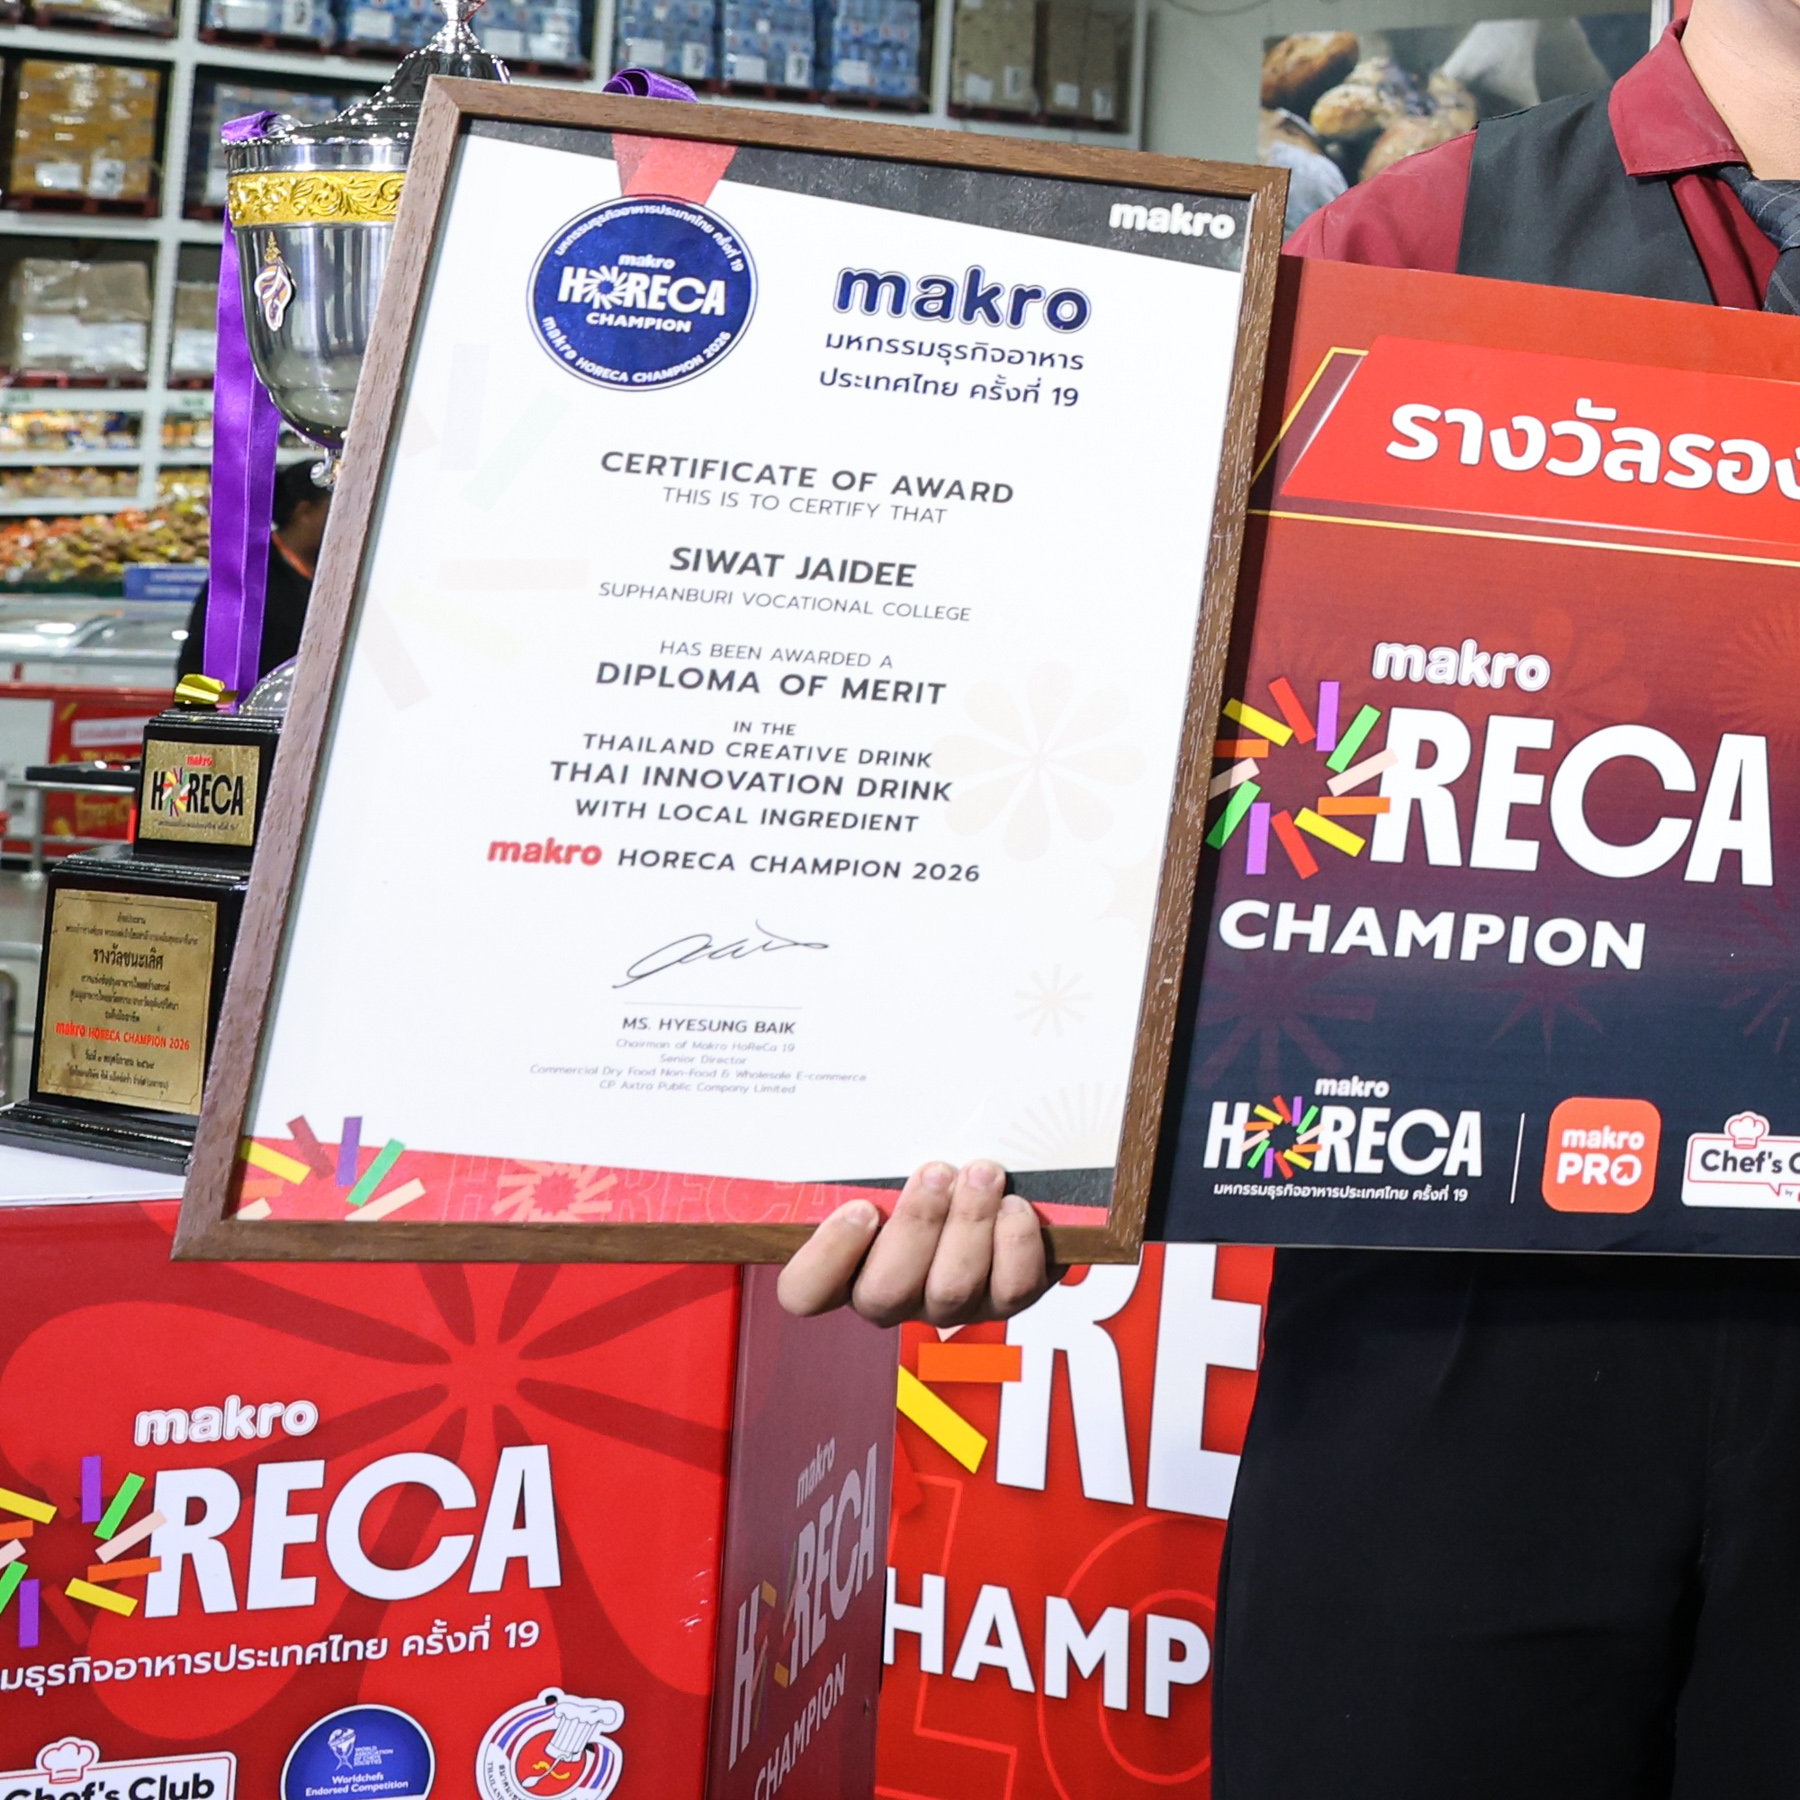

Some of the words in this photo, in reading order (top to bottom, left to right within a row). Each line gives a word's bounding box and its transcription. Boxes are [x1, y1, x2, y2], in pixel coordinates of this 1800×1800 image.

[1109, 201, 1236, 240] makro
[618, 254, 676, 270] makro
[558, 265, 726, 316] HORECA
[833, 265, 1092, 334] makro
[586, 312, 692, 333] CHAMPION
[542, 316, 577, 360] makro
[575, 358, 629, 382] HORECA
[632, 355, 704, 383] CHAMPION
[703, 331, 731, 359] 2026
[824, 333, 1085, 370] มหกรรมธุรกิจอาหาร
[819, 368, 959, 397] ประเทศไทย
[970, 374, 1040, 405] ครั้งที่
[1052, 386, 1079, 407] 19
[601, 451, 817, 488] CERTIFICATE
[831, 470, 877, 492] OF
[890, 475, 1014, 503] AWARD
[663, 486, 710, 506] THIS
[721, 491, 739, 508] IS
[750, 493, 780, 510] TO
[789, 497, 880, 518] CERTIFY
[890, 505, 947, 524] THAT
[670, 547, 785, 578] SIWAT
[795, 556, 917, 588] JAIDEE
[598, 581, 734, 605] SUPHANBURI
[742, 591, 874, 615] VOCATIONAL
[882, 602, 971, 621] COLLEGE
[659, 640, 702, 657] HAS
[710, 643, 762, 660] BEEN
[770, 648, 871, 667] AWARDED
[879, 655, 893, 668] A
[1372, 638, 1552, 692] makro
[596, 662, 760, 693] DIPLOMA
[779, 673, 827, 697] OF
[841, 677, 947, 705] MERIT
[733, 720, 752, 733] IN
[761, 722, 797, 736] THE
[583, 733, 715, 758] THAILAND
[725, 742, 847, 763] CREATIVE
[858, 749, 932, 769] DRINK
[151, 767, 243, 817] HORECA
[550, 761, 629, 785] THAI
[643, 766, 844, 796] INNOVATION
[856, 778, 952, 801] DRINK
[1208, 677, 1773, 887] ORECA
[575, 798, 646, 819] WITH
[658, 803, 749, 825] LOCAL
[760, 808, 919, 832] INGREDIENT
[487, 837, 602, 866] makro
[617, 848, 735, 871] HORECA
[750, 855, 901, 880] CHAMPION
[911, 862, 981, 882] 2026
[1218, 899, 1646, 970] CHAMPION
[88, 1028, 121, 1042] HORECA
[124, 1031, 166, 1048] CHAMPION
[169, 1038, 190, 1050] 2026
[622, 1017, 651, 1030] MS.
[659, 1018, 748, 1033] HYESUNG
[754, 1021, 796, 1035] BAIK
[659, 1053, 695, 1064] Senior
[700, 1055, 747, 1065] Director
[1314, 1075, 1390, 1099] makro
[1203, 1095, 1483, 1178] HORECA
[1562, 1125, 1645, 1150] makro
[1557, 1152, 1642, 1186] PRO
[1701, 1149, 1782, 1174] Chef's
[1213, 1180, 1409, 1202] มหกรรมธุรกิจอาหารประเทศไทย
[1412, 1179, 1450, 1202] ครั้งที่
[1453, 1186, 1468, 1202] 19
[134, 1394, 319, 1446] makro
[796, 1437, 836, 1507] makro
[0, 1444, 563, 1648] ORECA
[728, 1442, 877, 1772] HORECA
[0, 1634, 388, 1695] มธุรกิจอาหารประเทศไทย
[402, 1615, 490, 1659] ครั้งที่
[505, 1620, 540, 1650] 19
[884, 1566, 1211, 1719] HAMP
[754, 1654, 846, 1800] CHAMPION
[128, 1773, 215, 1800] Club
[305, 1784, 349, 1797] Endorsed
[351, 1781, 408, 1793] Competition
[332, 1772, 384, 1785] Worldchefs
